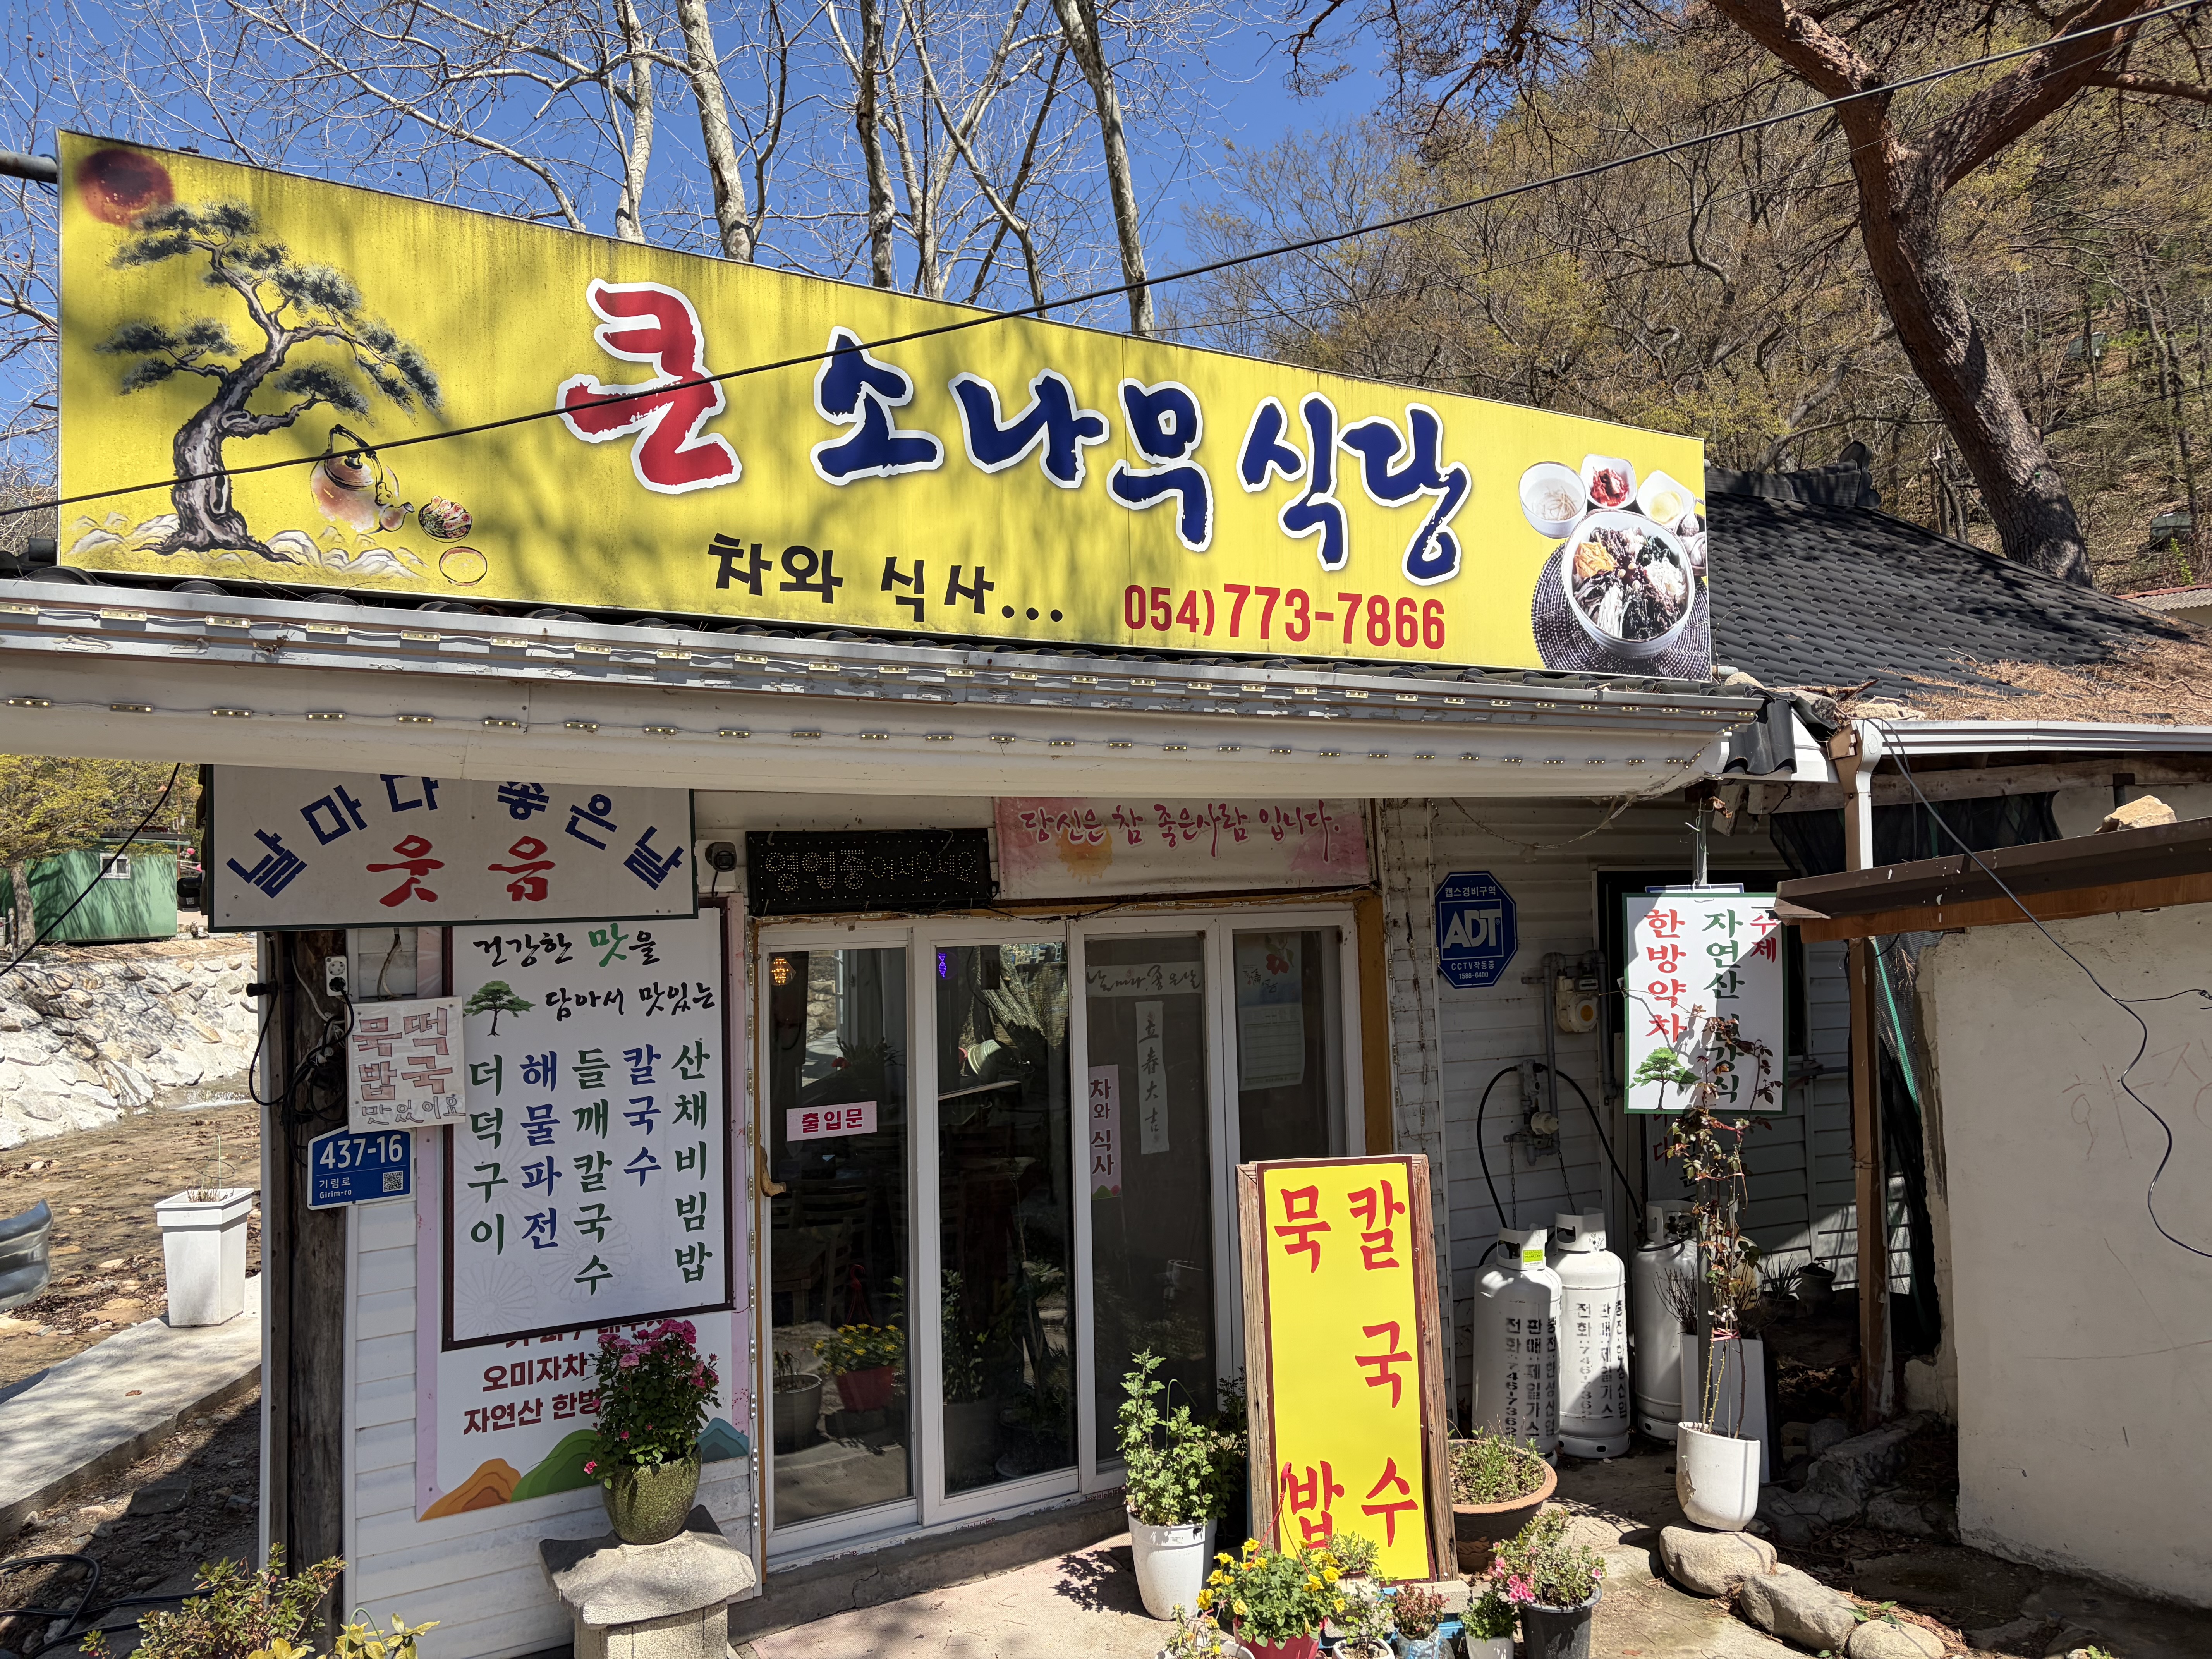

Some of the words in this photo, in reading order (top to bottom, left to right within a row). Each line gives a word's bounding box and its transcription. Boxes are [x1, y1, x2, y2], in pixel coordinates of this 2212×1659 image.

[565, 286, 734, 486] 큰
[817, 331, 1210, 547] 소나무
[1243, 395, 1466, 579] 식당
[708, 533, 843, 605] 차와
[226, 774, 439, 898] 날마다
[1020, 807, 1105, 843] 당신은
[1112, 804, 1144, 845] 참
[765, 849, 866, 892] 영업중
[1445, 886, 1496, 898] 캡스경비구역
[473, 932, 574, 967] 건강한
[588, 922, 661, 967] 맛을
[1443, 909, 1501, 948] ADT
[1749, 914, 1778, 963] 수제
[1458, 971, 1489, 979] 1588-6400
[1644, 909, 1688, 1042] 한방약차
[1702, 909, 1745, 999] 자연산
[546, 987, 625, 1022] 담아서
[639, 982, 716, 1017] 맛있는
[1090, 1078, 1112, 1120] 차와
[1139, 1020, 1159, 1133] 立春大吉
[362, 1096, 466, 1125] 맛있어요
[623, 1044, 662, 1187] 칼국수
[802, 1108, 863, 1134] 출입문
[319, 1134, 403, 1170] 437-16
[467, 1054, 509, 1255] 더덕구이
[519, 1051, 562, 1250] 해물파전
[572, 1048, 613, 1296] 들깨칼국수
[671, 1041, 713, 1284] 산채비빔밥
[1091, 1129, 1115, 1176] 식사
[319, 1176, 351, 1188] 기림로
[319, 1189, 352, 1199] Girim-ro
[483, 1352, 587, 1392] 오미자차
[1274, 1185, 1344, 1549] 묵밥
[1347, 1180, 1417, 1547] 칼국수
[464, 1397, 544, 1436] 자연산
